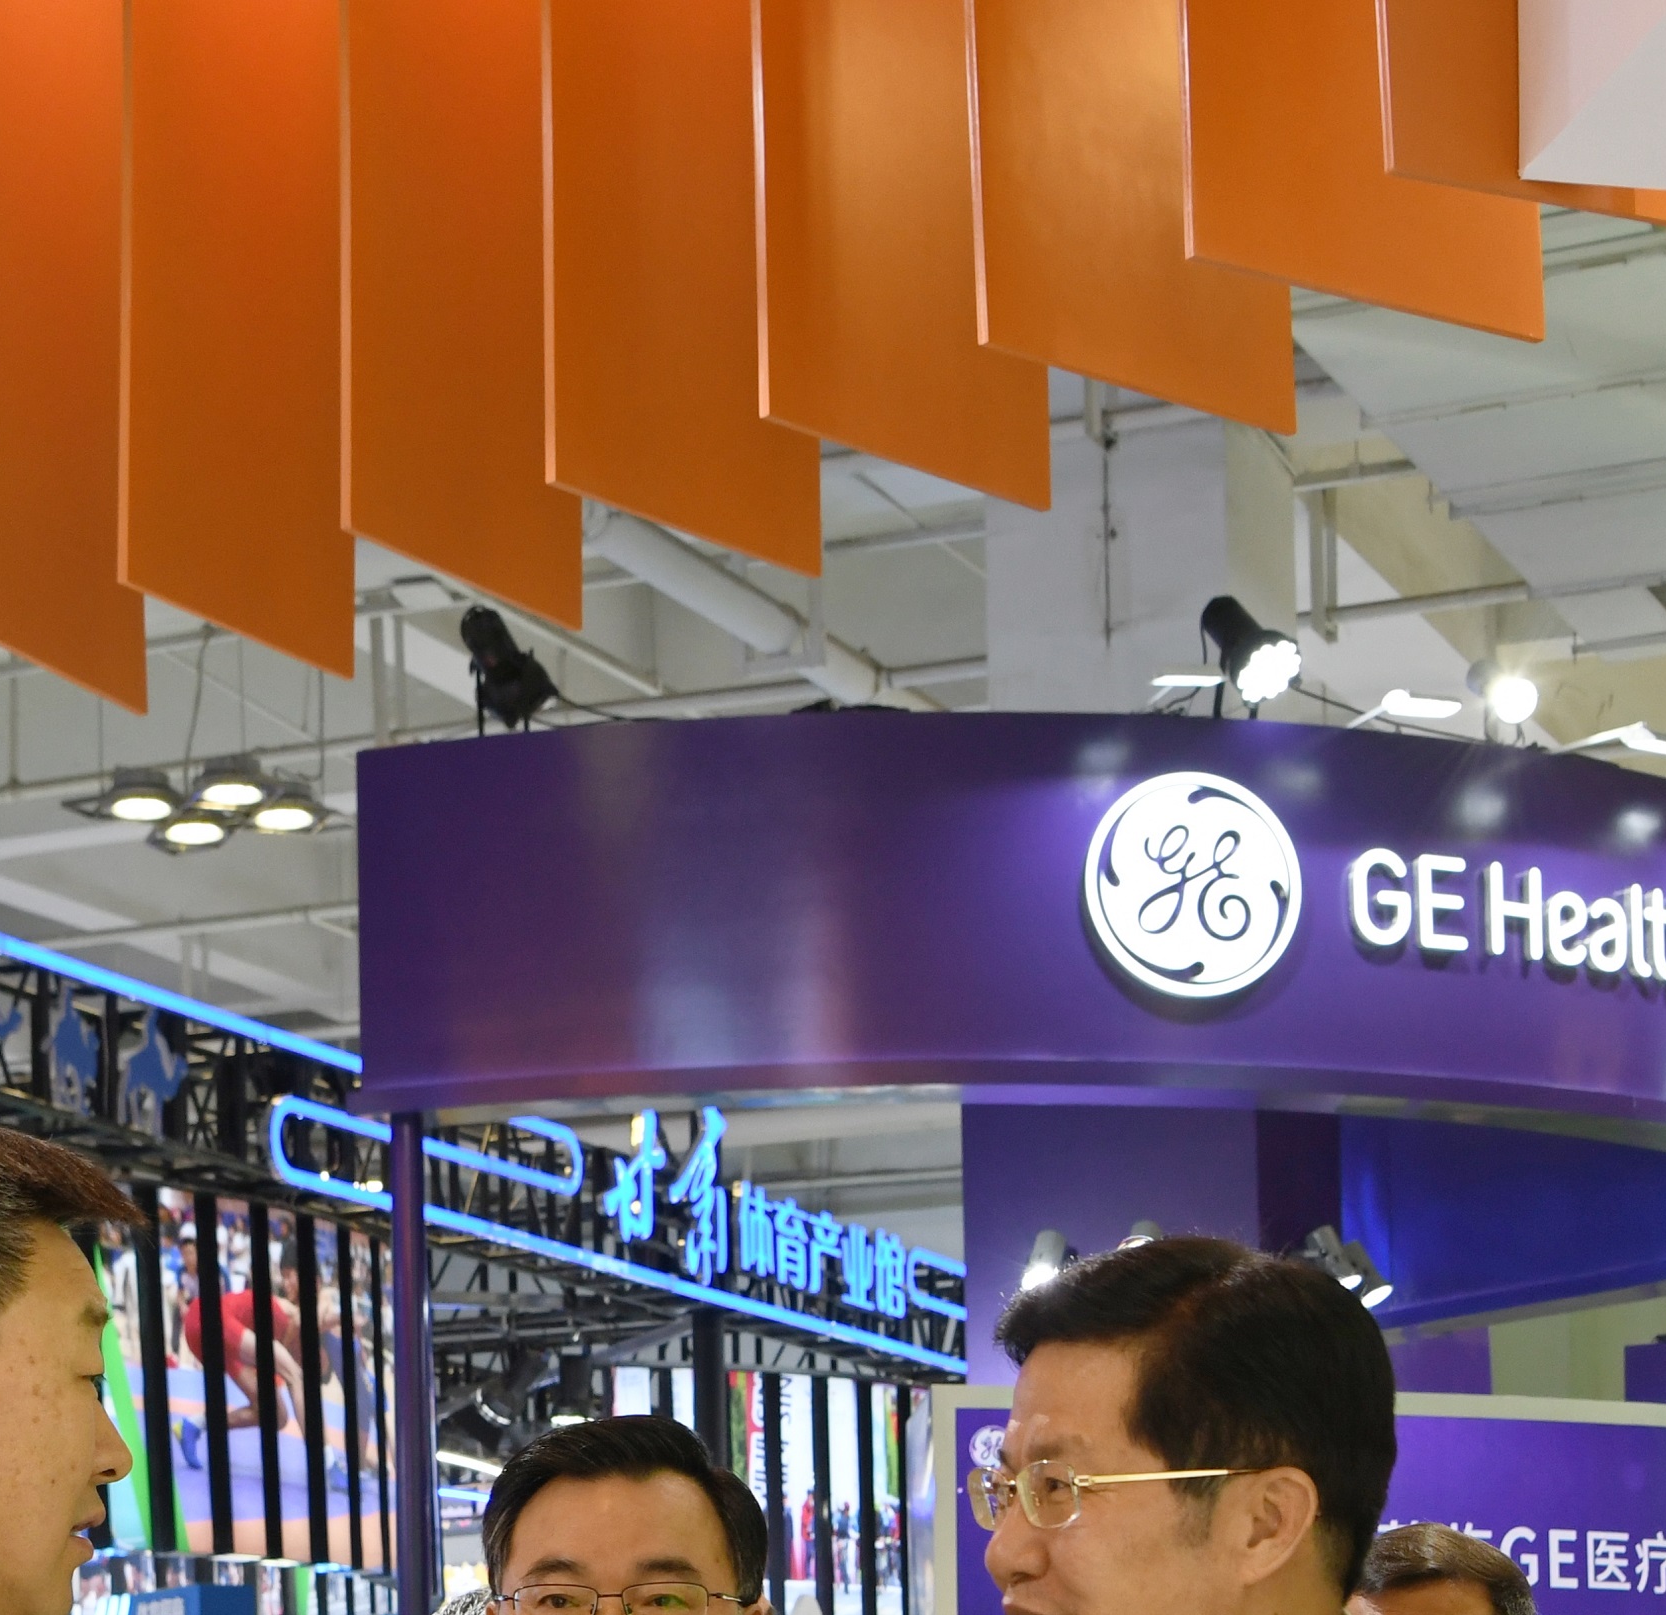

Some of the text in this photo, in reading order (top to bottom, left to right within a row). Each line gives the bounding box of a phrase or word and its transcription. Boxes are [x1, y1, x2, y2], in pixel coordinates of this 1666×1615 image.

[1349, 847, 1471, 953] GE
[602, 1104, 910, 1321] 甘肃 体育产业馆
